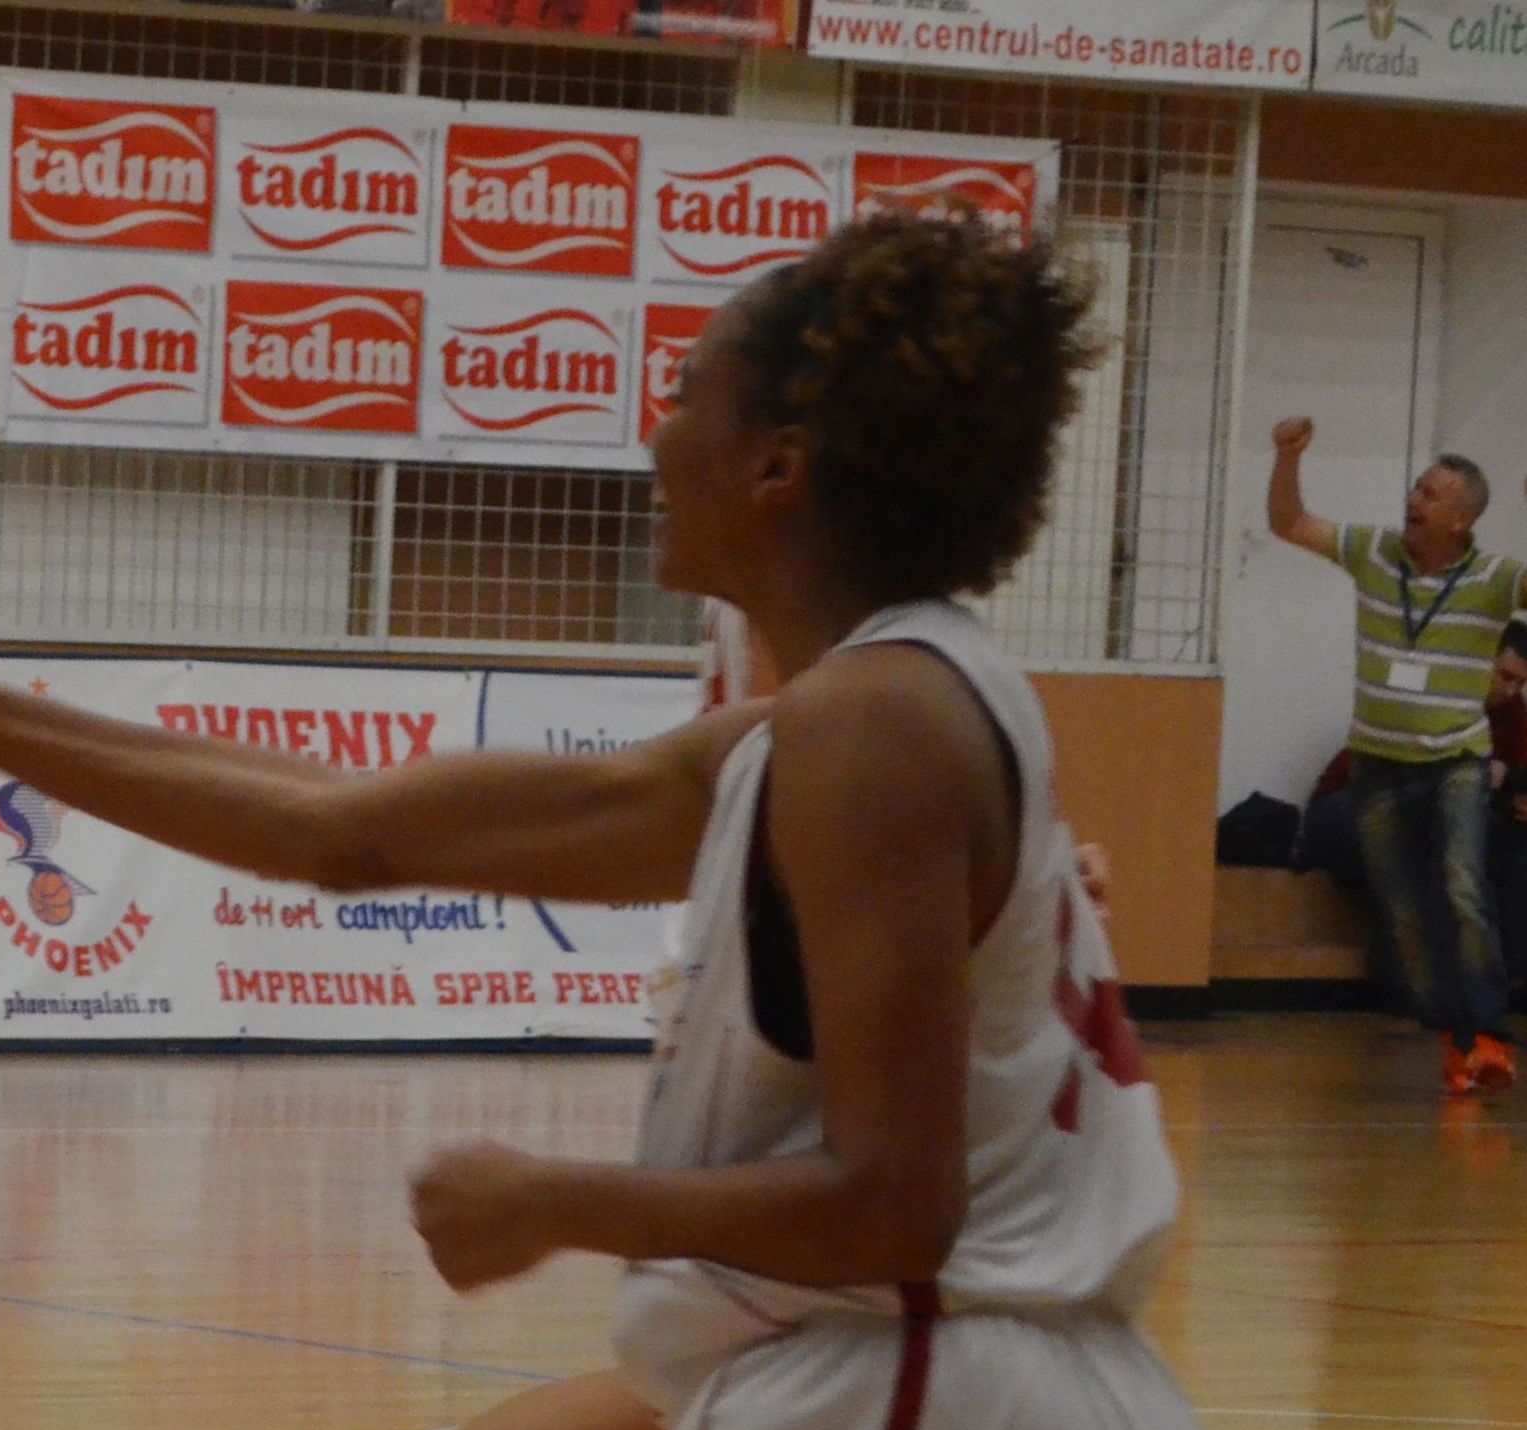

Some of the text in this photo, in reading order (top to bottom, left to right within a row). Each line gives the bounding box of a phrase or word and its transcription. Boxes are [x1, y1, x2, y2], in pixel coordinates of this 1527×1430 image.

[815, 12, 1303, 76] www.centrul-de-sanatate.ro
[1336, 41, 1420, 79] Arcada
[216, 960, 416, 1006] ÎMPREUNĂ
[434, 970, 536, 1007] SPRE
